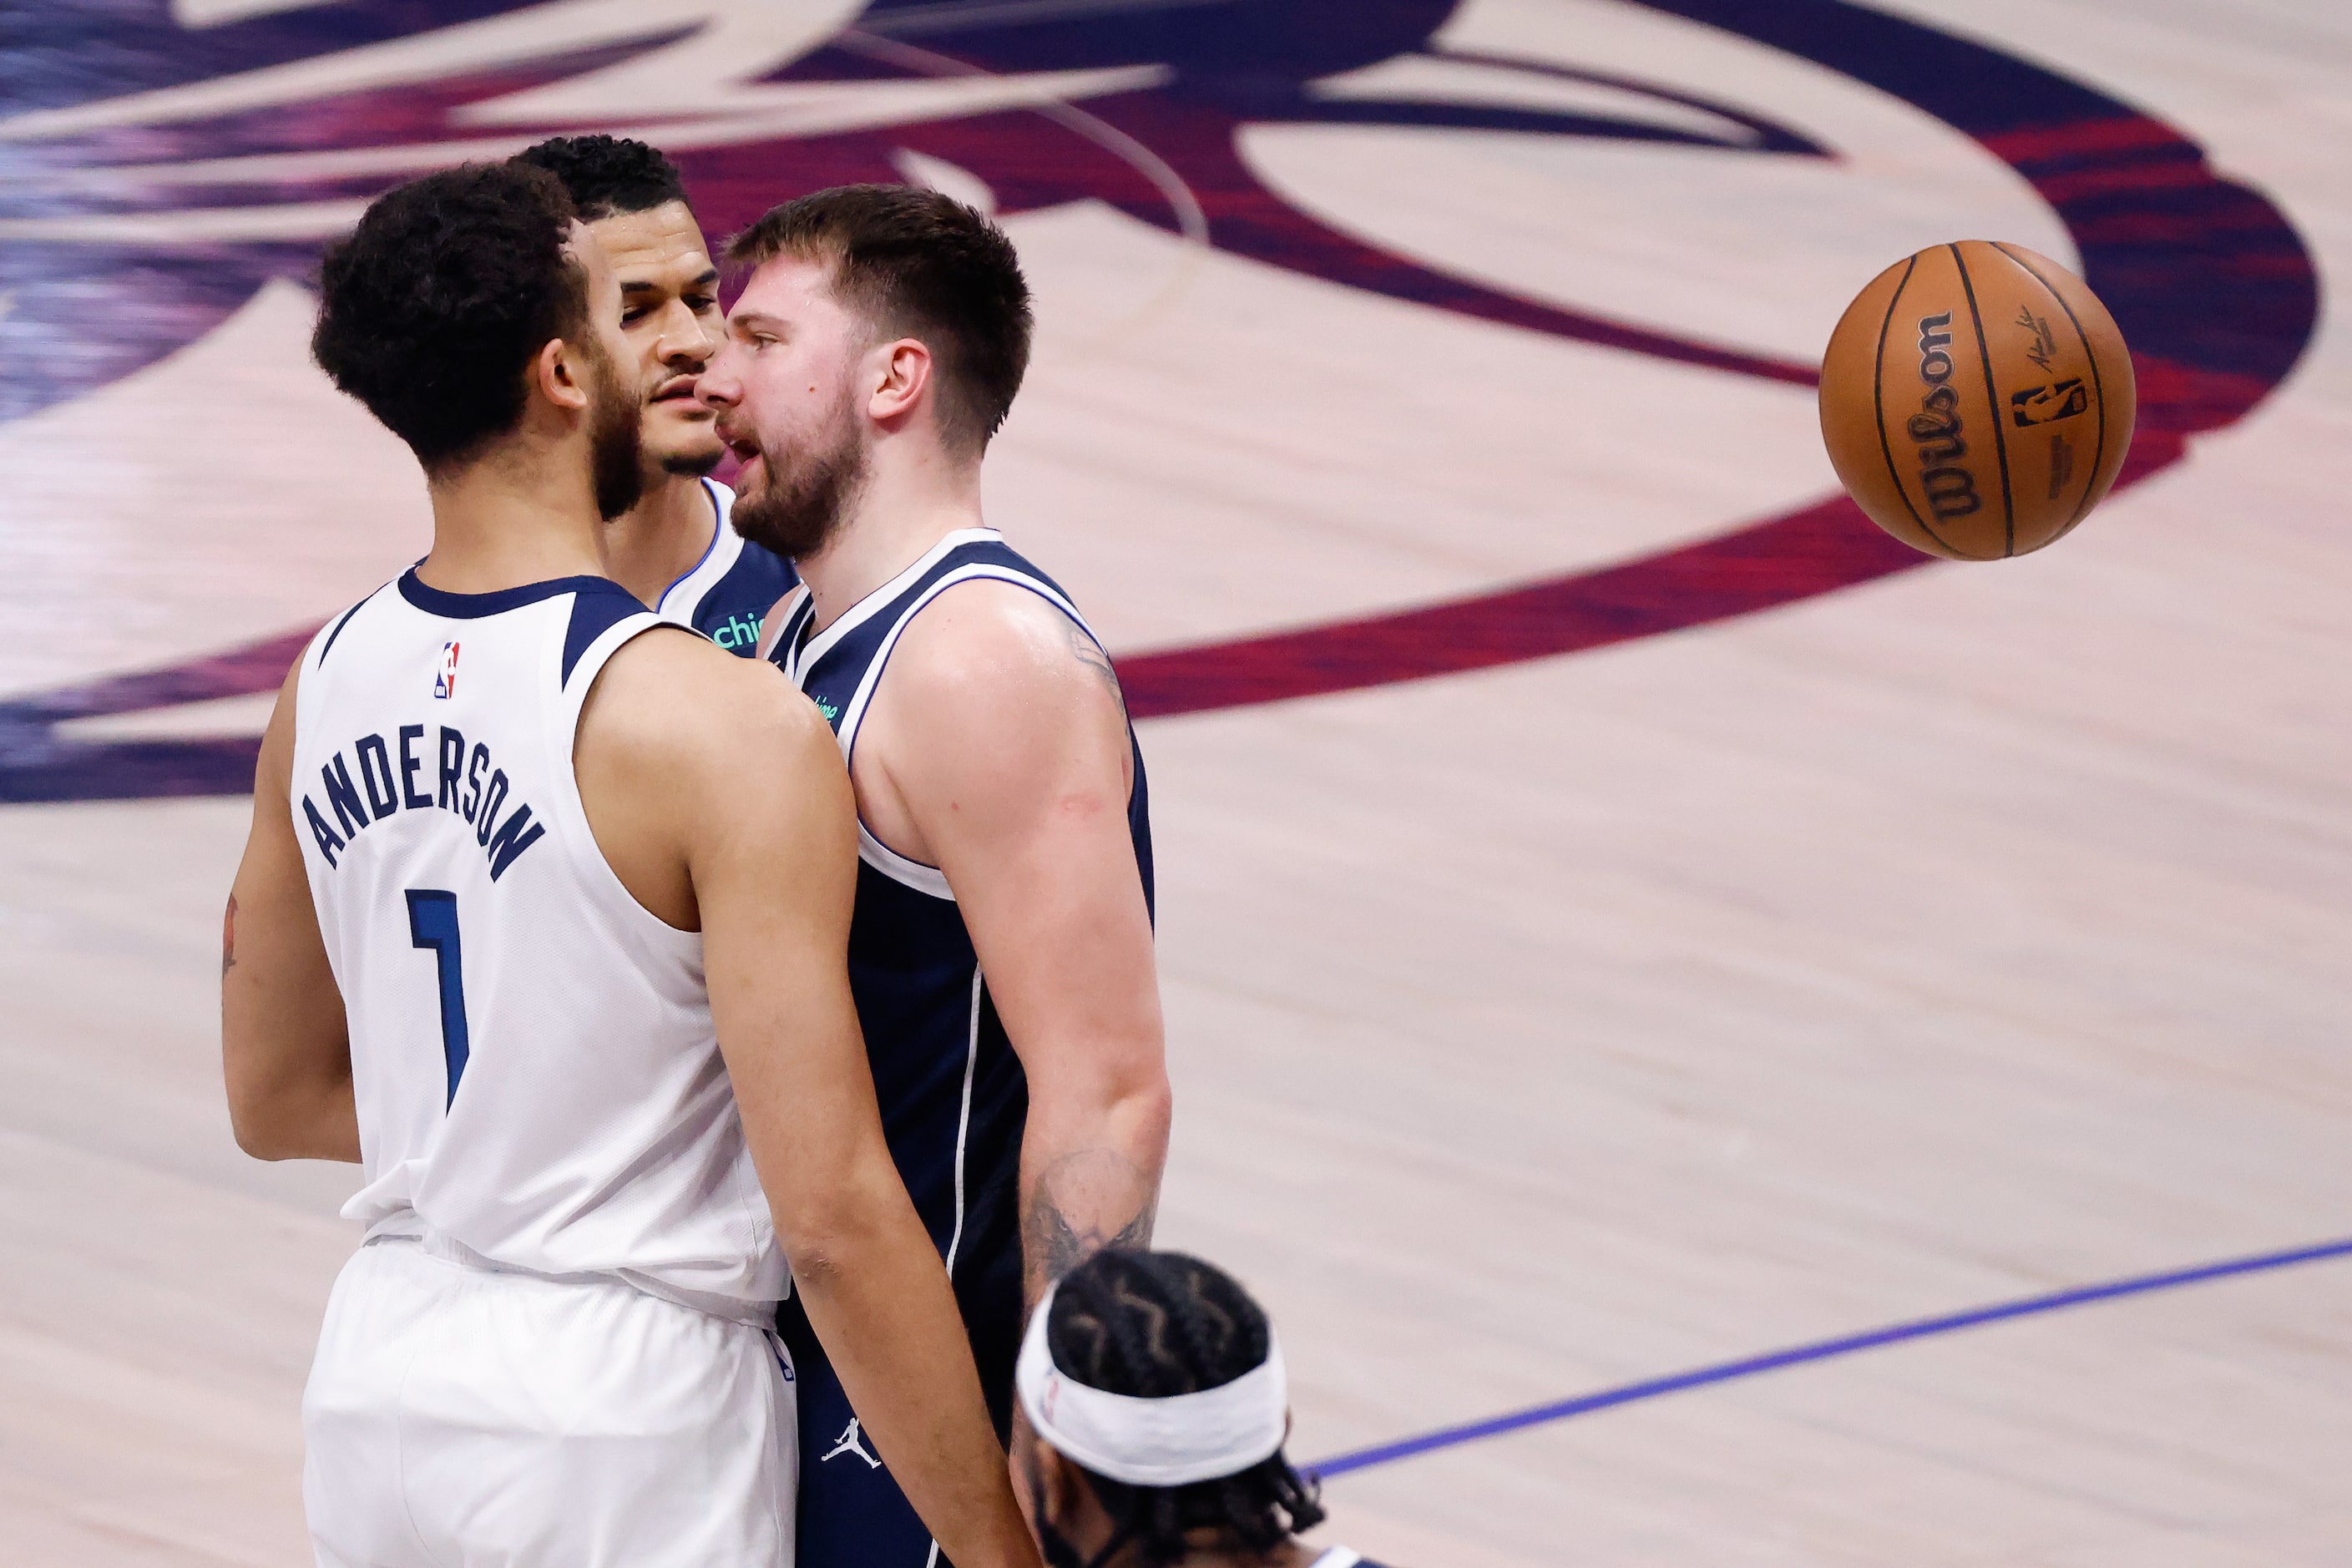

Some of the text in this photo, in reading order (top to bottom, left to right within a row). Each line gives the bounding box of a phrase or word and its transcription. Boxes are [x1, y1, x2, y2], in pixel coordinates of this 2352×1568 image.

[1909, 310, 1981, 524] Wilson
[714, 613, 765, 649] chi
[302, 724, 545, 883] ANDERSON
[404, 889, 469, 1118] 1
